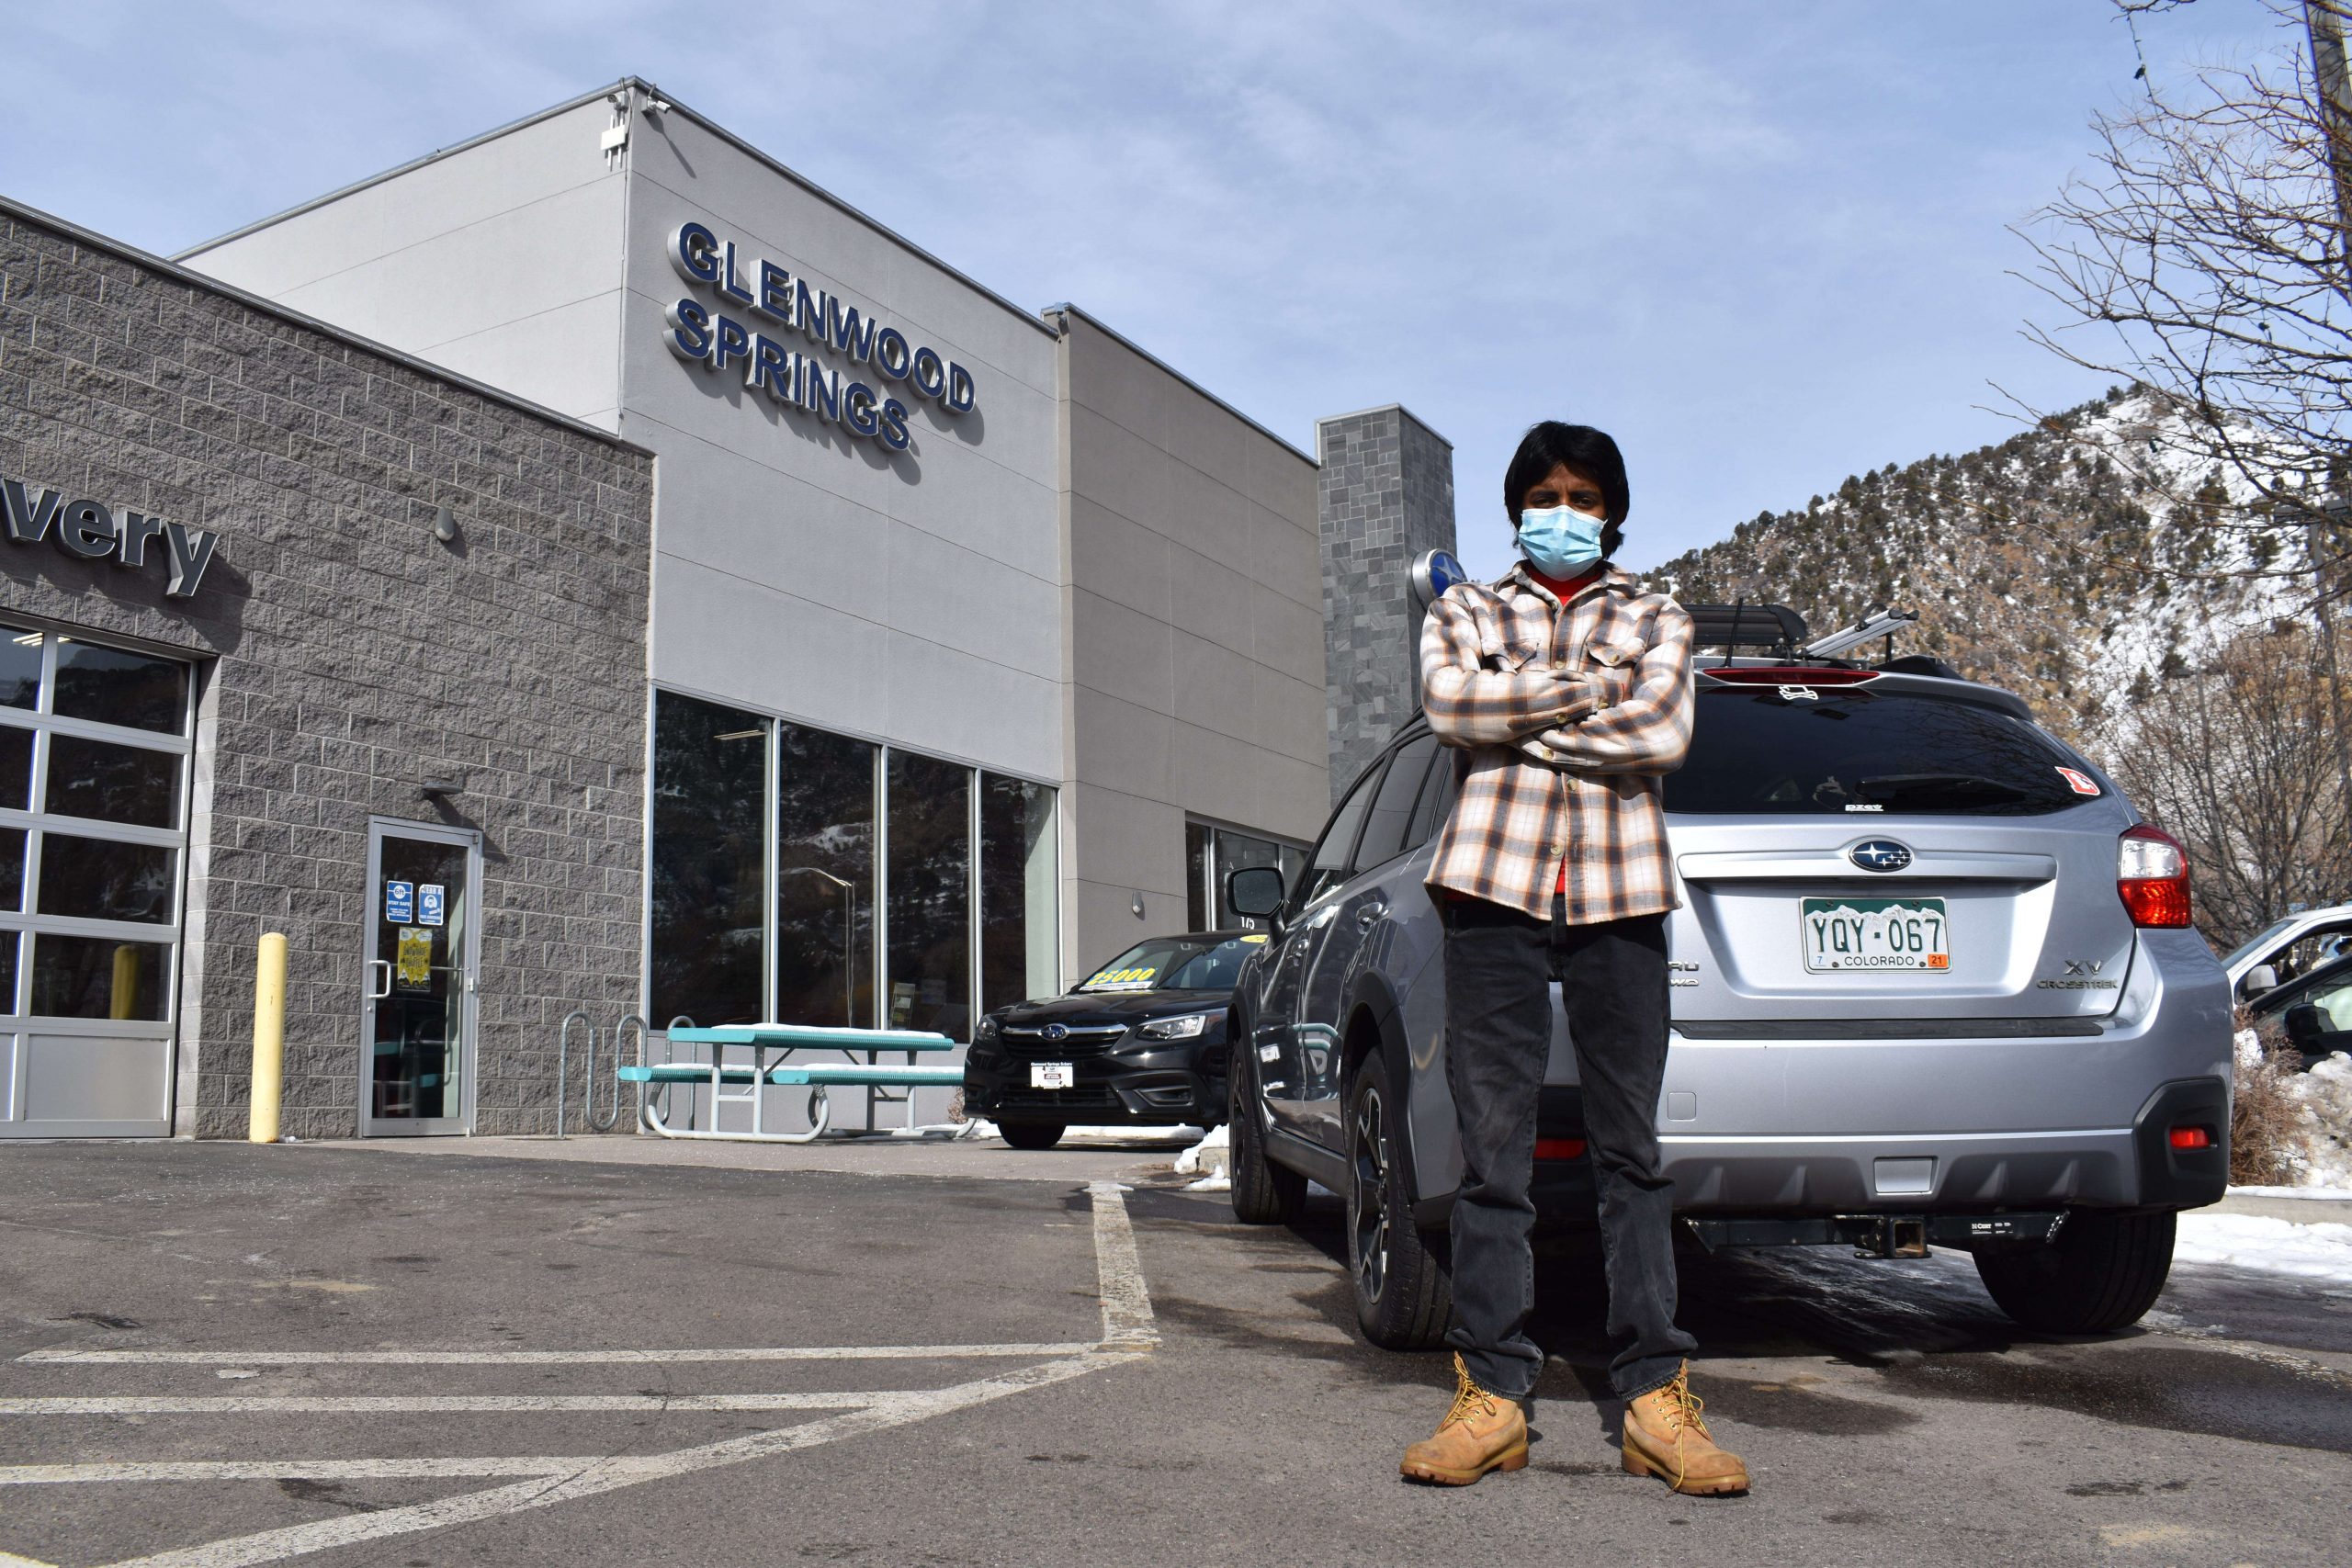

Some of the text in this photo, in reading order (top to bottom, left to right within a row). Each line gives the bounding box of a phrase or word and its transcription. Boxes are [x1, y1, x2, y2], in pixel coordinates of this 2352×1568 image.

[668, 221, 975, 413] GLENWOOD
[663, 299, 910, 450] SPRINGS
[1, 478, 219, 596] very
[395, 887, 405, 896] 6ft
[1844, 956, 1915, 965] COLORADO
[1931, 955, 1943, 964] 21
[2064, 960, 2101, 975] XV
[2037, 980, 2118, 989] CROSSTREK
